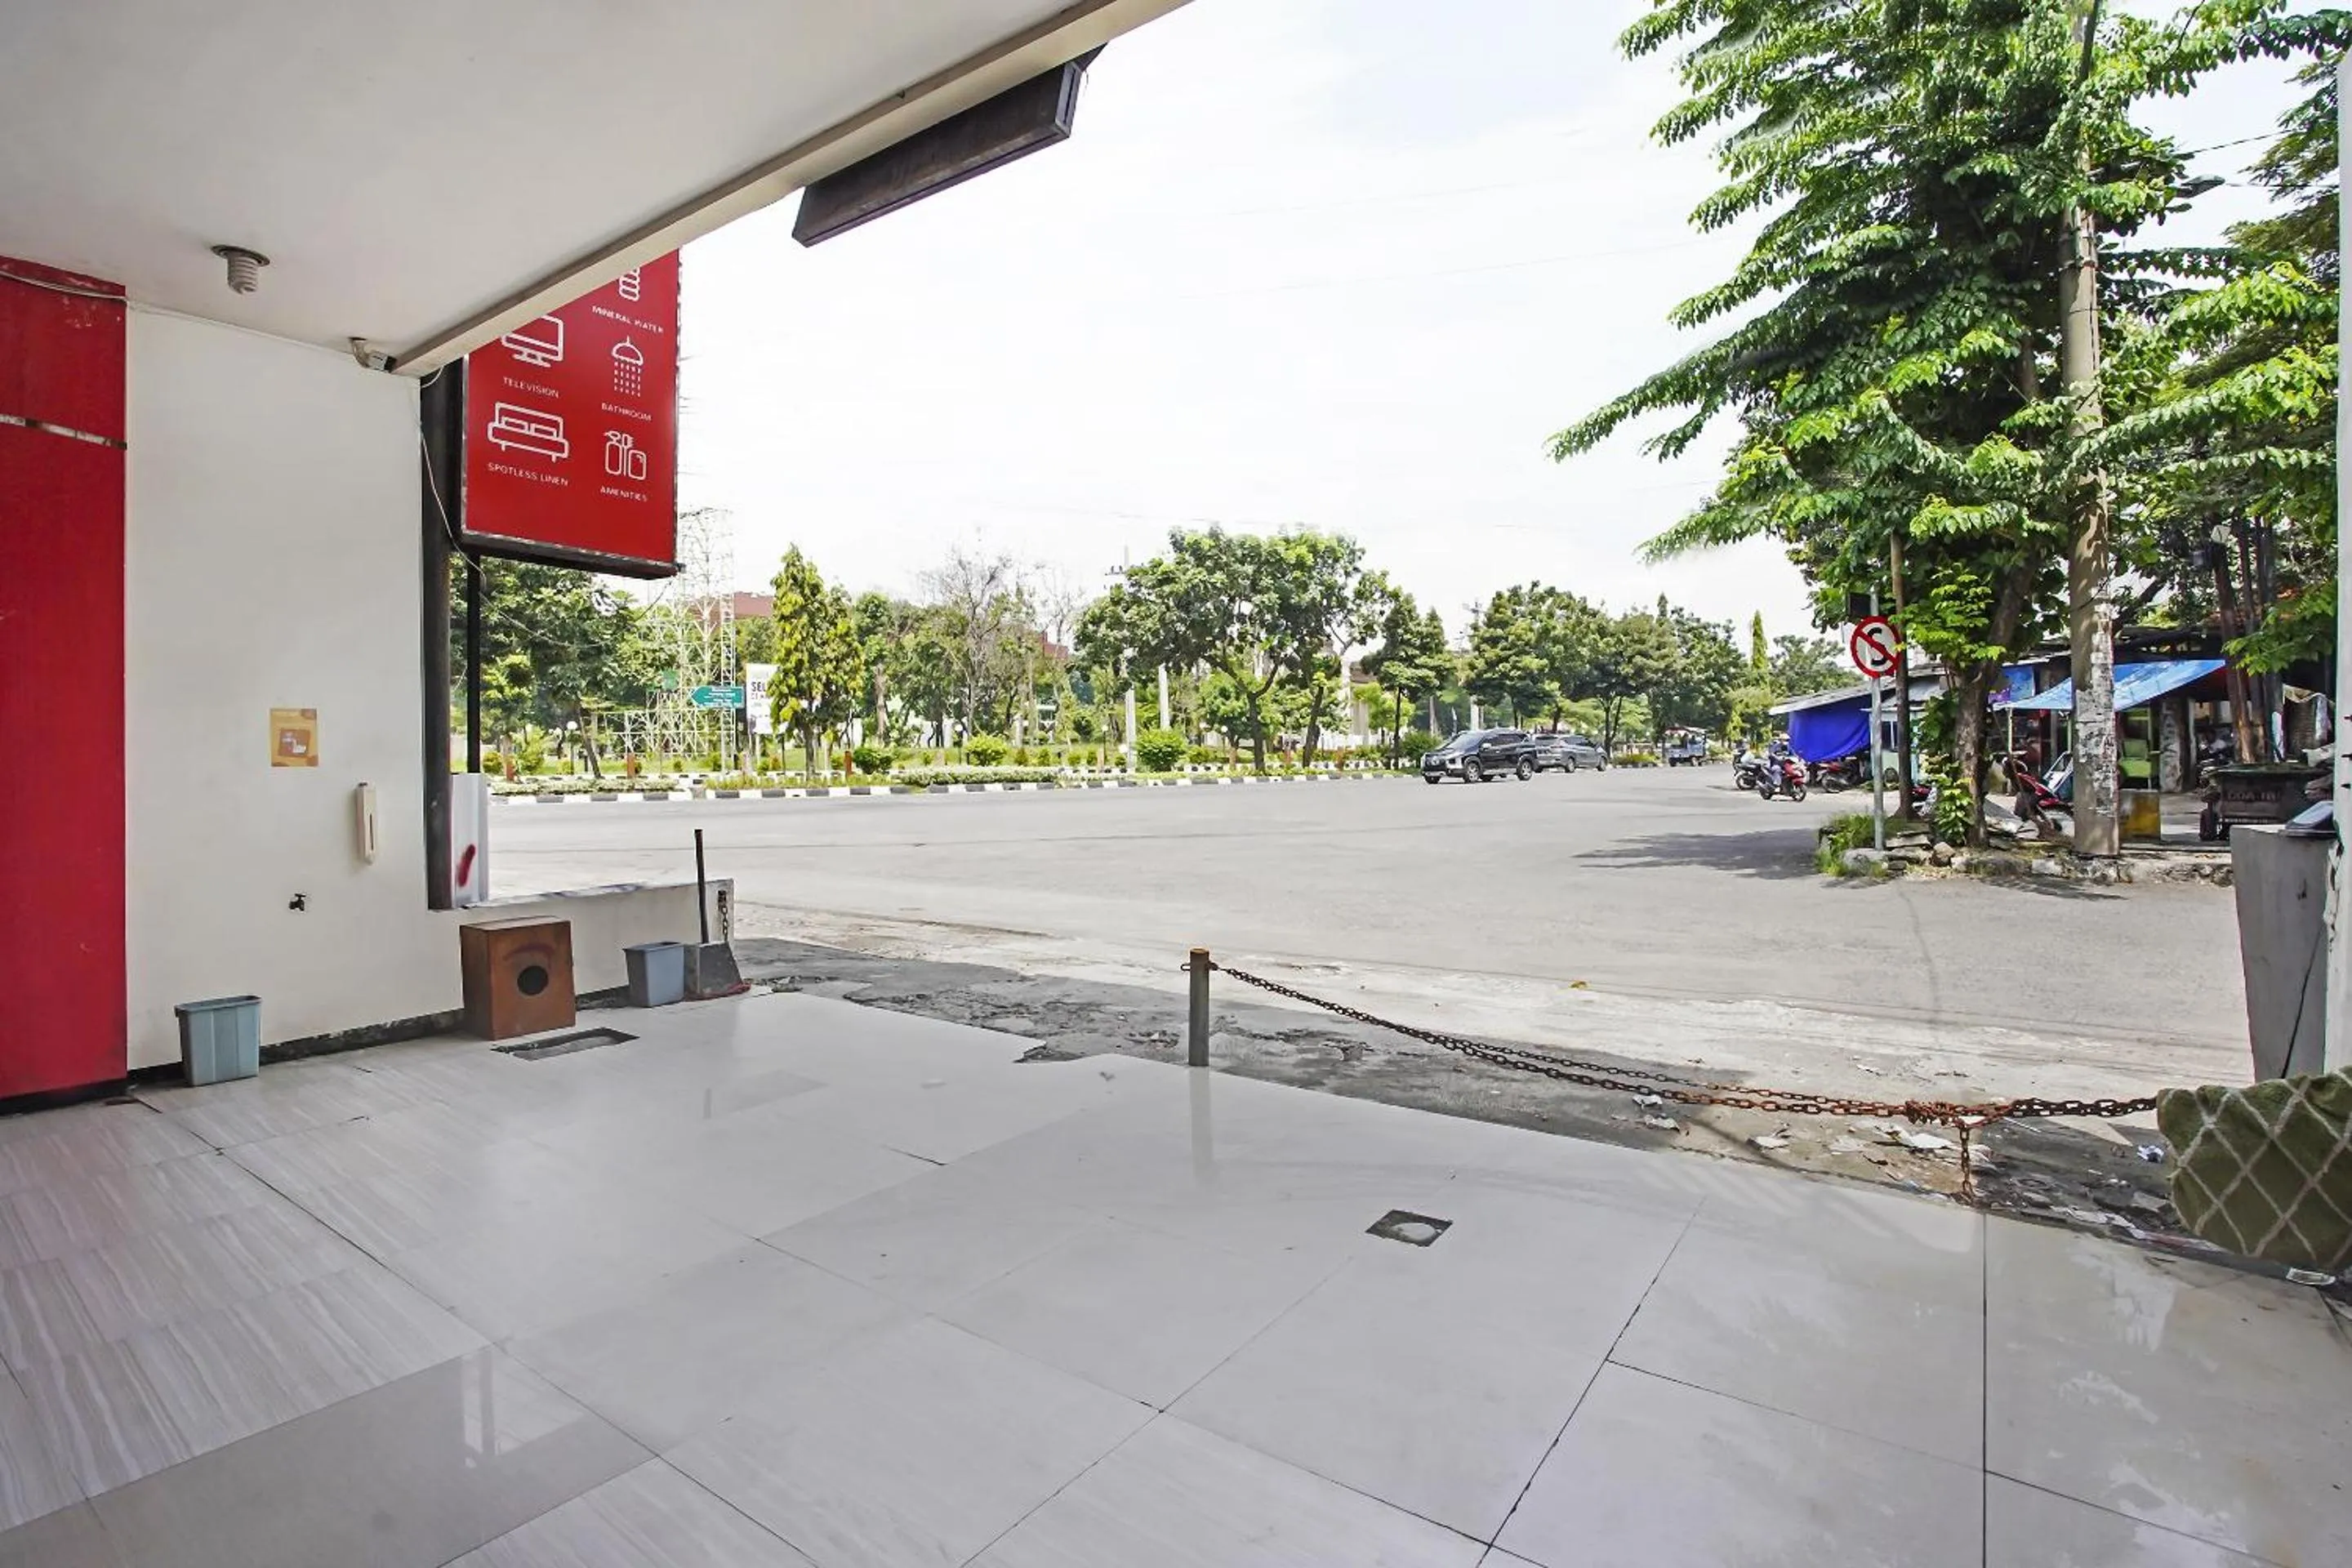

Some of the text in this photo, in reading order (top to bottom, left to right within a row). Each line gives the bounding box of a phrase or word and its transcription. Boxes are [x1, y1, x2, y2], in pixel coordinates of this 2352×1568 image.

[592, 305, 664, 334] MINERAL WATER
[503, 376, 559, 399] TELEVISION
[601, 403, 652, 421] BATHROOM
[488, 462, 568, 487] SPOTLESS LINEN
[600, 486, 648, 501] AMENITIES
